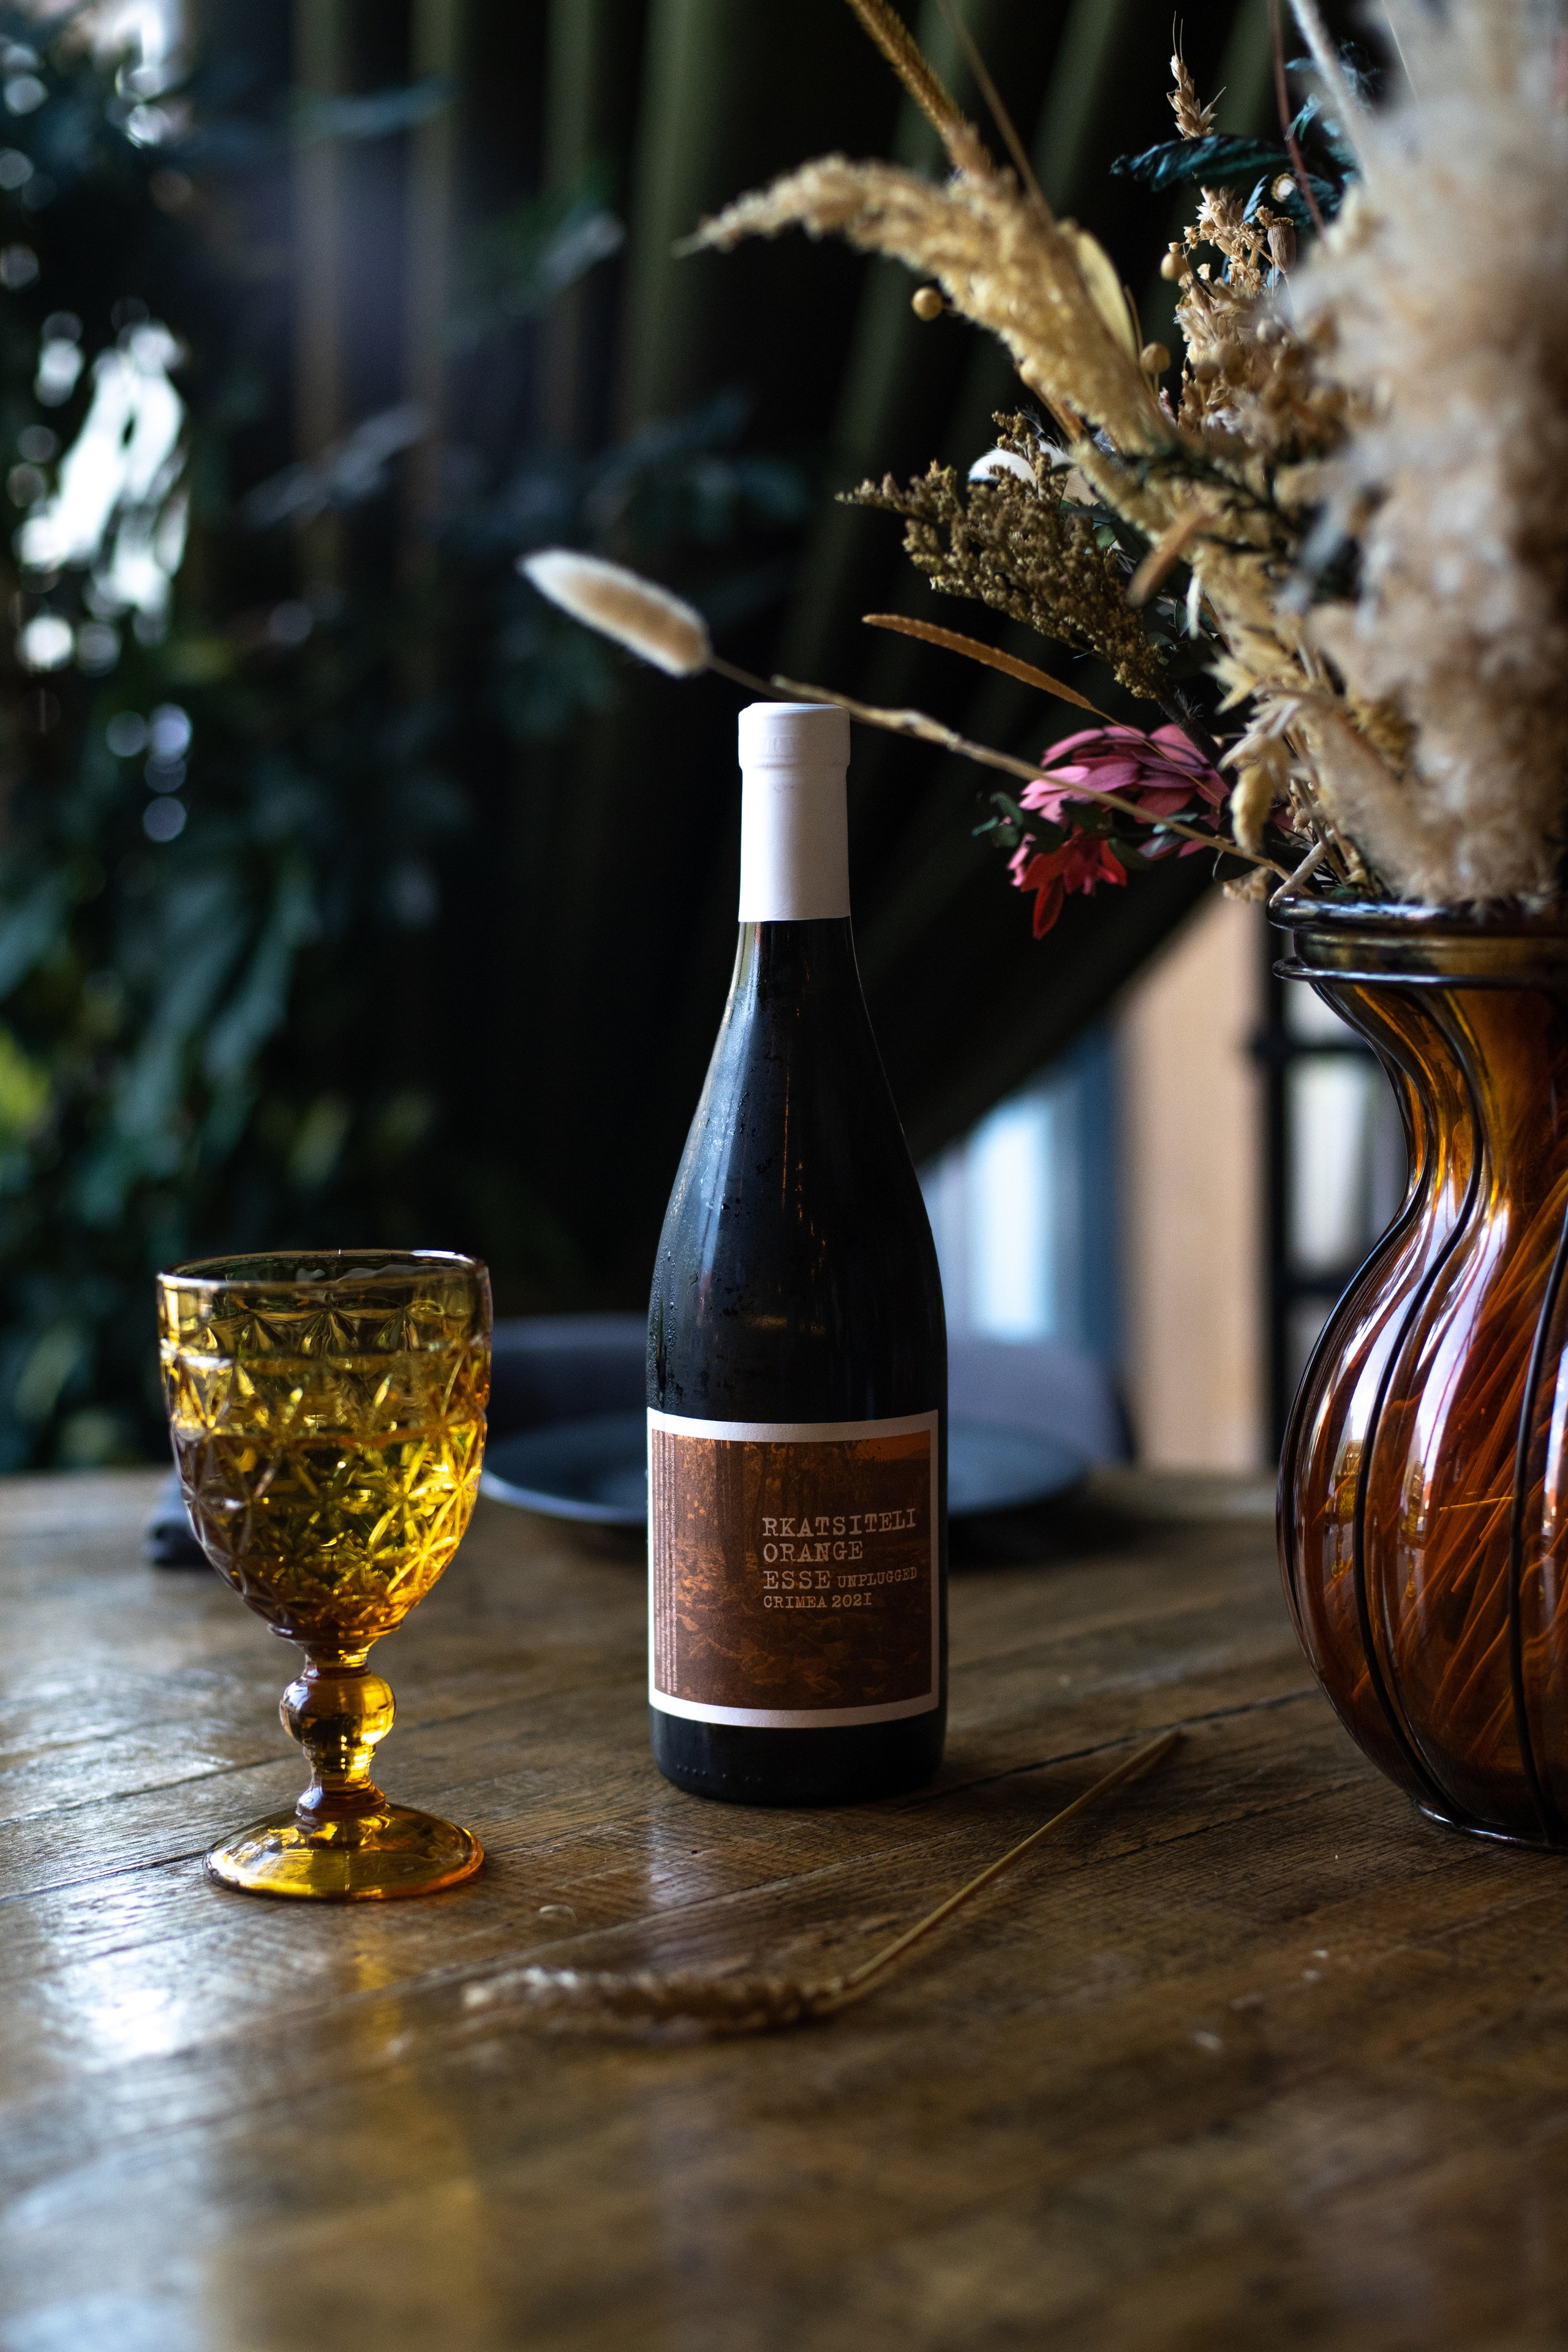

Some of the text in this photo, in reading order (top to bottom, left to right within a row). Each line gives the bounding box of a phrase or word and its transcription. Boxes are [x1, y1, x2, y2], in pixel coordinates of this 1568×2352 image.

[762, 1508, 916, 1537] RKATSITELI
[763, 1540, 863, 1562] ORANGE
[763, 1567, 918, 1589] ESSE UNPLUGGED
[764, 1593, 872, 1608] CRIMEA 2021
